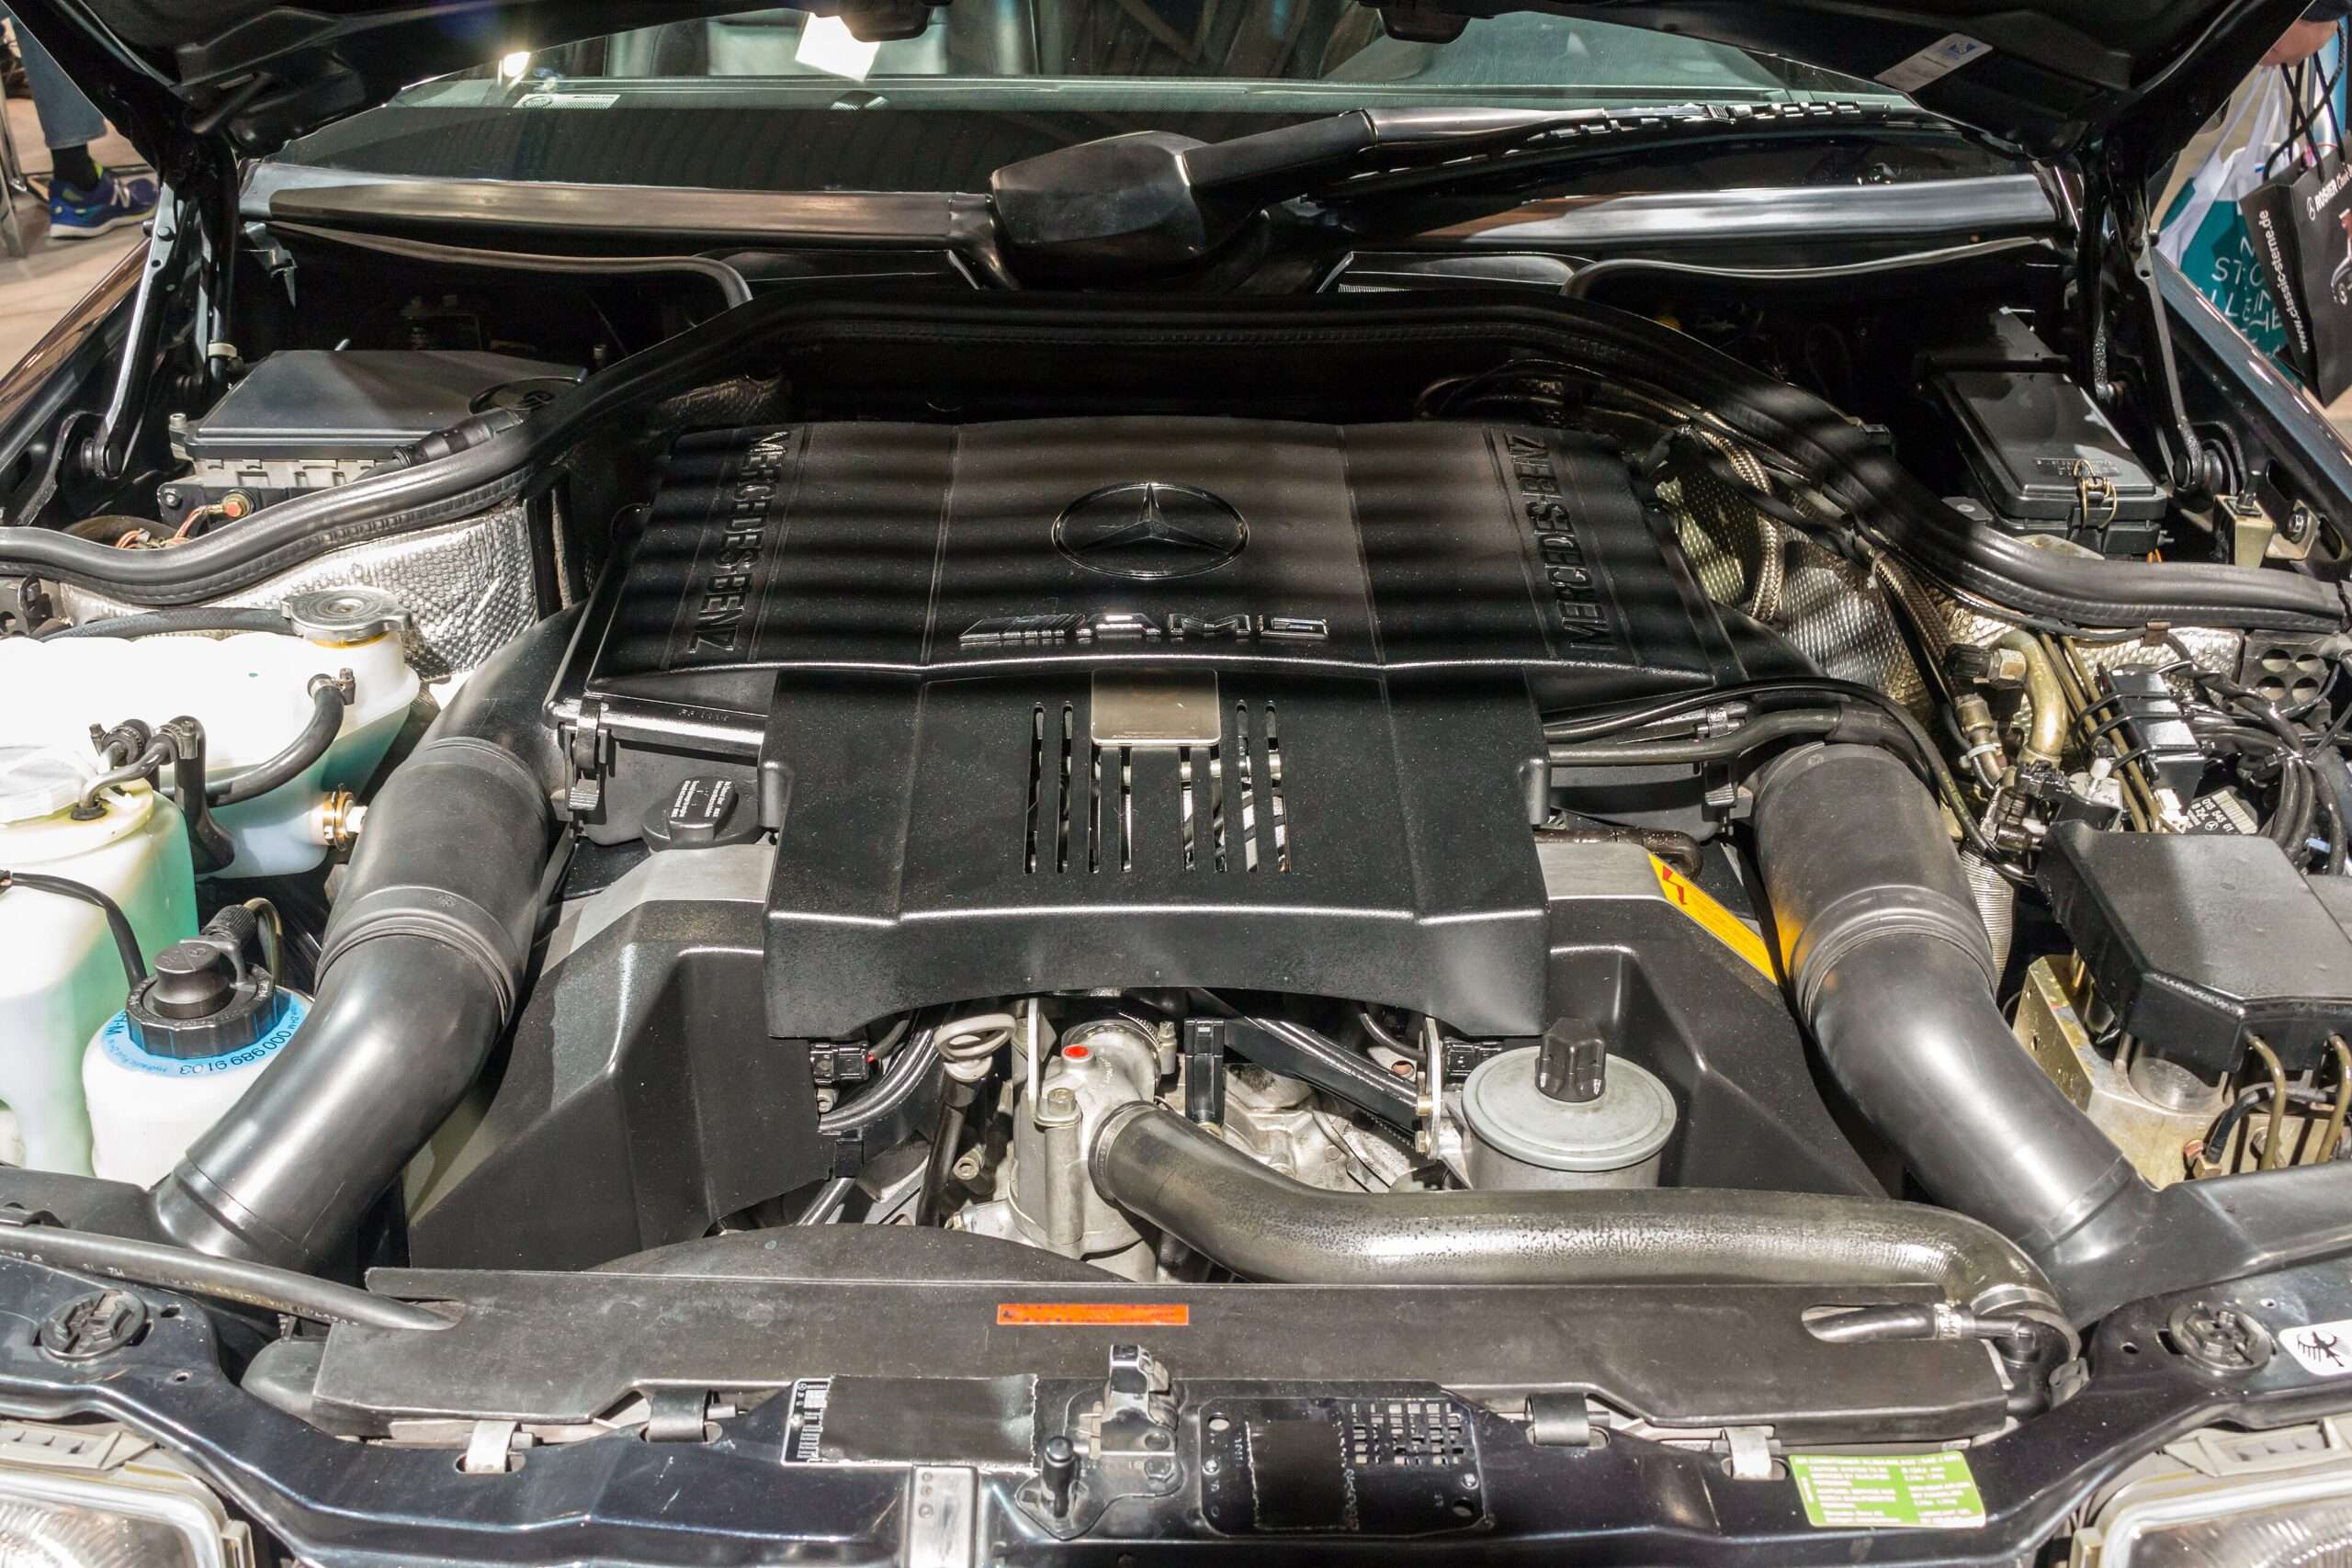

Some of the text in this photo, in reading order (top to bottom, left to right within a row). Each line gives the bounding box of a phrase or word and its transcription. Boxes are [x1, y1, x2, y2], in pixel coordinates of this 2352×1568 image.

[687, 430, 791, 655] MERCEDES-BENZ
[1504, 434, 1618, 651] MERCEDES-BENZ
[179, 1030, 292, 1075] 000 989 91 03
